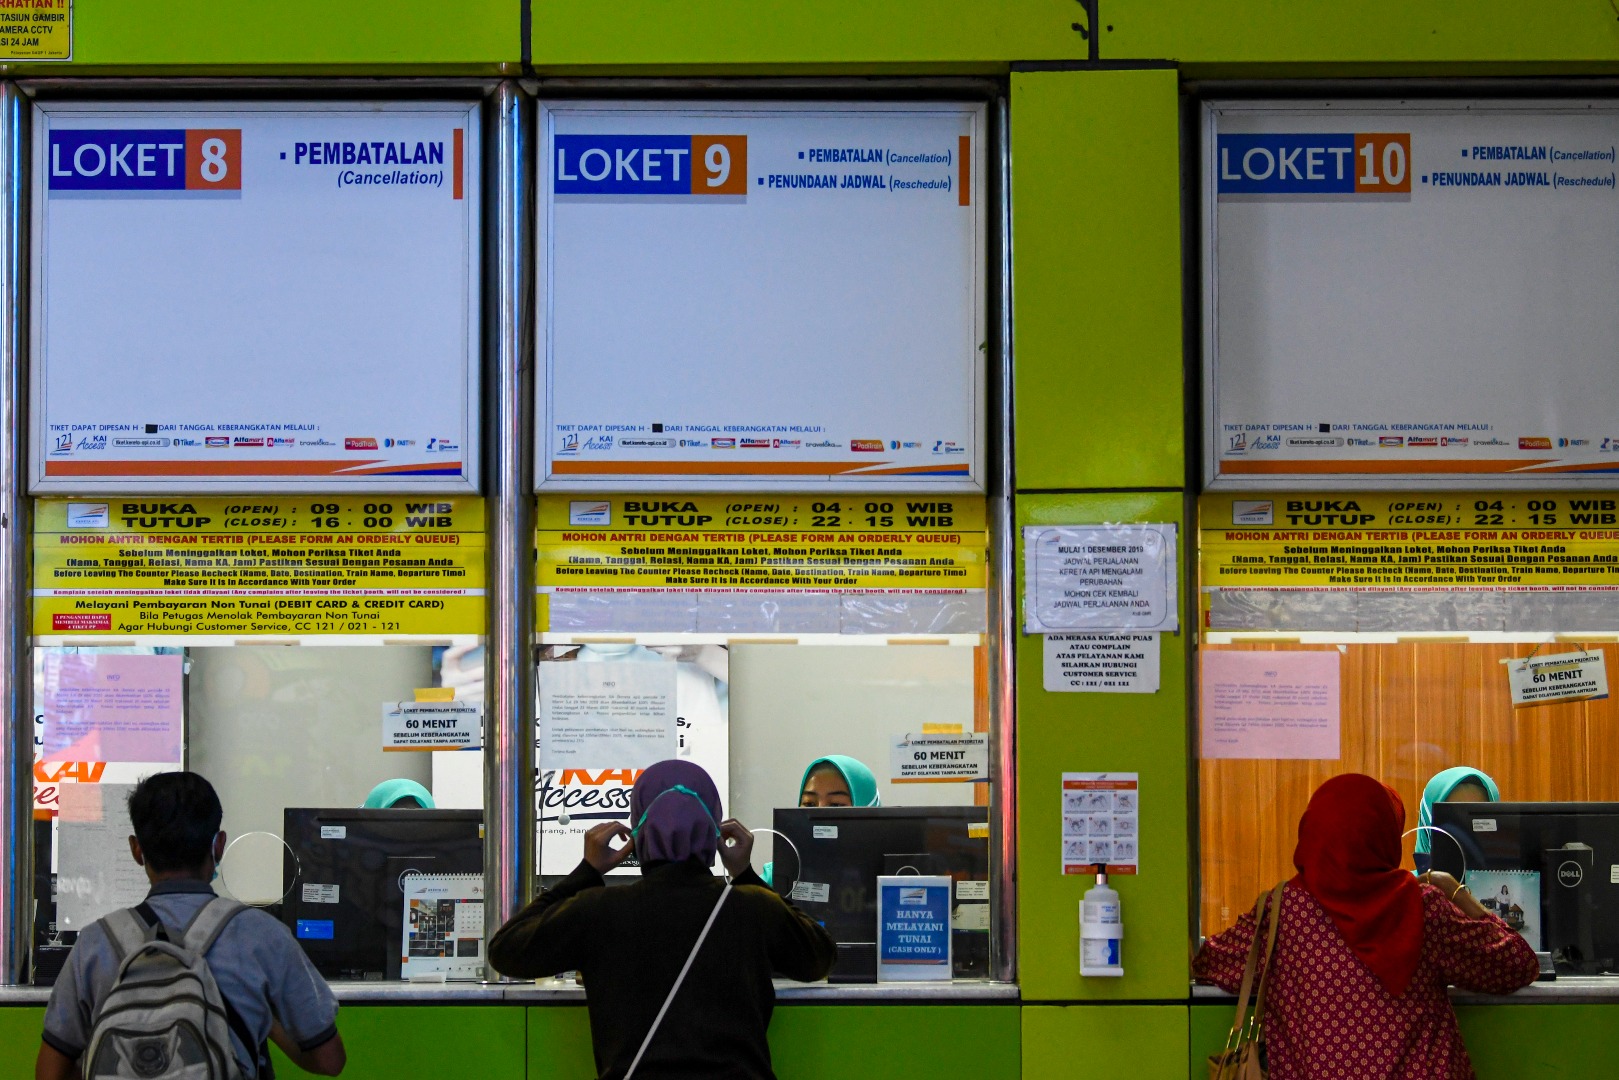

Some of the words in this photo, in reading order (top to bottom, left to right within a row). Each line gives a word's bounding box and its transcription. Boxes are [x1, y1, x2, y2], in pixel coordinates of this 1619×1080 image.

[32, 13, 64, 22] GAMBIR
[30, 26, 53, 34] CCTV
[11, 38, 20, 46] 24
[22, 38, 39, 46] JAM
[295, 142, 443, 164] PEMBATALAN
[809, 148, 882, 162] PEMBATALAN
[886, 149, 952, 166] (Cancellation)
[1472, 146, 1546, 160] PEMBATALAN
[1550, 146, 1615, 164] (Cancellation)
[53, 144, 183, 176] LOKET
[200, 138, 228, 182] 8
[558, 148, 688, 181] LOKET
[704, 144, 730, 187] 9
[1222, 148, 1352, 180] LOKET
[1360, 142, 1406, 185] 10
[338, 170, 443, 188] (Cancellation)
[768, 174, 837, 188] PENUNDAAN
[840, 175, 886, 188] JADWAL
[889, 175, 951, 192] (Reschedule)
[1432, 172, 1501, 186] PENUNDAAN
[1504, 172, 1550, 186] JADWAL
[1553, 172, 1616, 189] (Reschedule)
[76, 437, 107, 450] Access
[122, 504, 197, 514] BUKA
[224, 505, 278, 515] (OPEN)
[310, 504, 340, 514] 09
[364, 503, 392, 514] 00
[405, 503, 452, 514] WIB
[624, 502, 698, 512] BUKA
[726, 504, 780, 514] (OPEN)
[812, 502, 841, 513] 04
[864, 502, 894, 513] 00
[906, 502, 953, 513] WIB
[1287, 500, 1361, 512] BUKA
[1388, 502, 1442, 512] (OPEN)
[1474, 500, 1504, 511] 04
[1527, 500, 1556, 511] 00
[1569, 500, 1616, 511] WIB
[120, 516, 211, 528] TUTUP
[224, 518, 287, 528] (CLOSE)
[311, 517, 340, 528] 16
[363, 517, 392, 528] 00
[405, 517, 452, 528] WIB
[623, 515, 712, 526] TUTUP
[726, 516, 788, 526] (CLOSE)
[811, 516, 840, 526] 22
[865, 516, 893, 527] 15
[906, 516, 953, 526] WIB
[1286, 514, 1376, 525] TUTUP
[1388, 515, 1451, 525] (CLOSE)
[1475, 514, 1504, 525] 22
[1528, 514, 1556, 525] 15
[1569, 513, 1616, 524] WIB
[60, 536, 104, 544] MOHON
[108, 535, 144, 544] ANTRI
[148, 535, 198, 544] DENGAN
[201, 535, 244, 544] TERTIB
[247, 535, 296, 545] (PLEASE
[300, 535, 333, 544] FORM
[336, 535, 353, 544] AN
[357, 535, 412, 544] ORDERLY
[415, 535, 460, 545] QUEUE)
[562, 533, 606, 541] MOHON
[610, 533, 646, 542] ANTRI
[650, 534, 699, 542] DENGAN
[702, 534, 745, 542] TERTIB
[749, 534, 797, 544] (PLEASE
[801, 534, 834, 542] FORM
[838, 534, 854, 542] AN
[858, 534, 912, 542] ORDERLY
[916, 534, 960, 544] QUEUE)
[1226, 532, 1270, 540] MOHON
[1273, 532, 1309, 540] ANTRI
[1313, 532, 1362, 540] DENGAN
[1365, 532, 1408, 540] TERTIB
[1412, 532, 1460, 542] (PLEASE
[1464, 532, 1498, 540] FORM
[1501, 532, 1518, 540] AN
[1521, 531, 1576, 540] ORDERLY
[76, 600, 128, 610] Melayani
[133, 600, 207, 610] Pembayaran
[211, 600, 235, 608] Non
[239, 600, 270, 608] Tunai
[274, 600, 312, 610] (DEBIT
[316, 600, 348, 608] CARD
[364, 600, 405, 608] CREDIT
[408, 600, 444, 610] CARD)
[1533, 674, 1546, 684] 60
[1549, 669, 1583, 681] MENIT
[1548, 680, 1596, 691] KEBERANGKATAN
[406, 720, 419, 728] 60
[422, 720, 458, 728] MENIT
[914, 752, 927, 760] 60
[930, 751, 966, 760] MENIT
[897, 910, 933, 919] HANYA
[886, 922, 943, 931] MELAYANI
[898, 935, 931, 943] TUNAI
